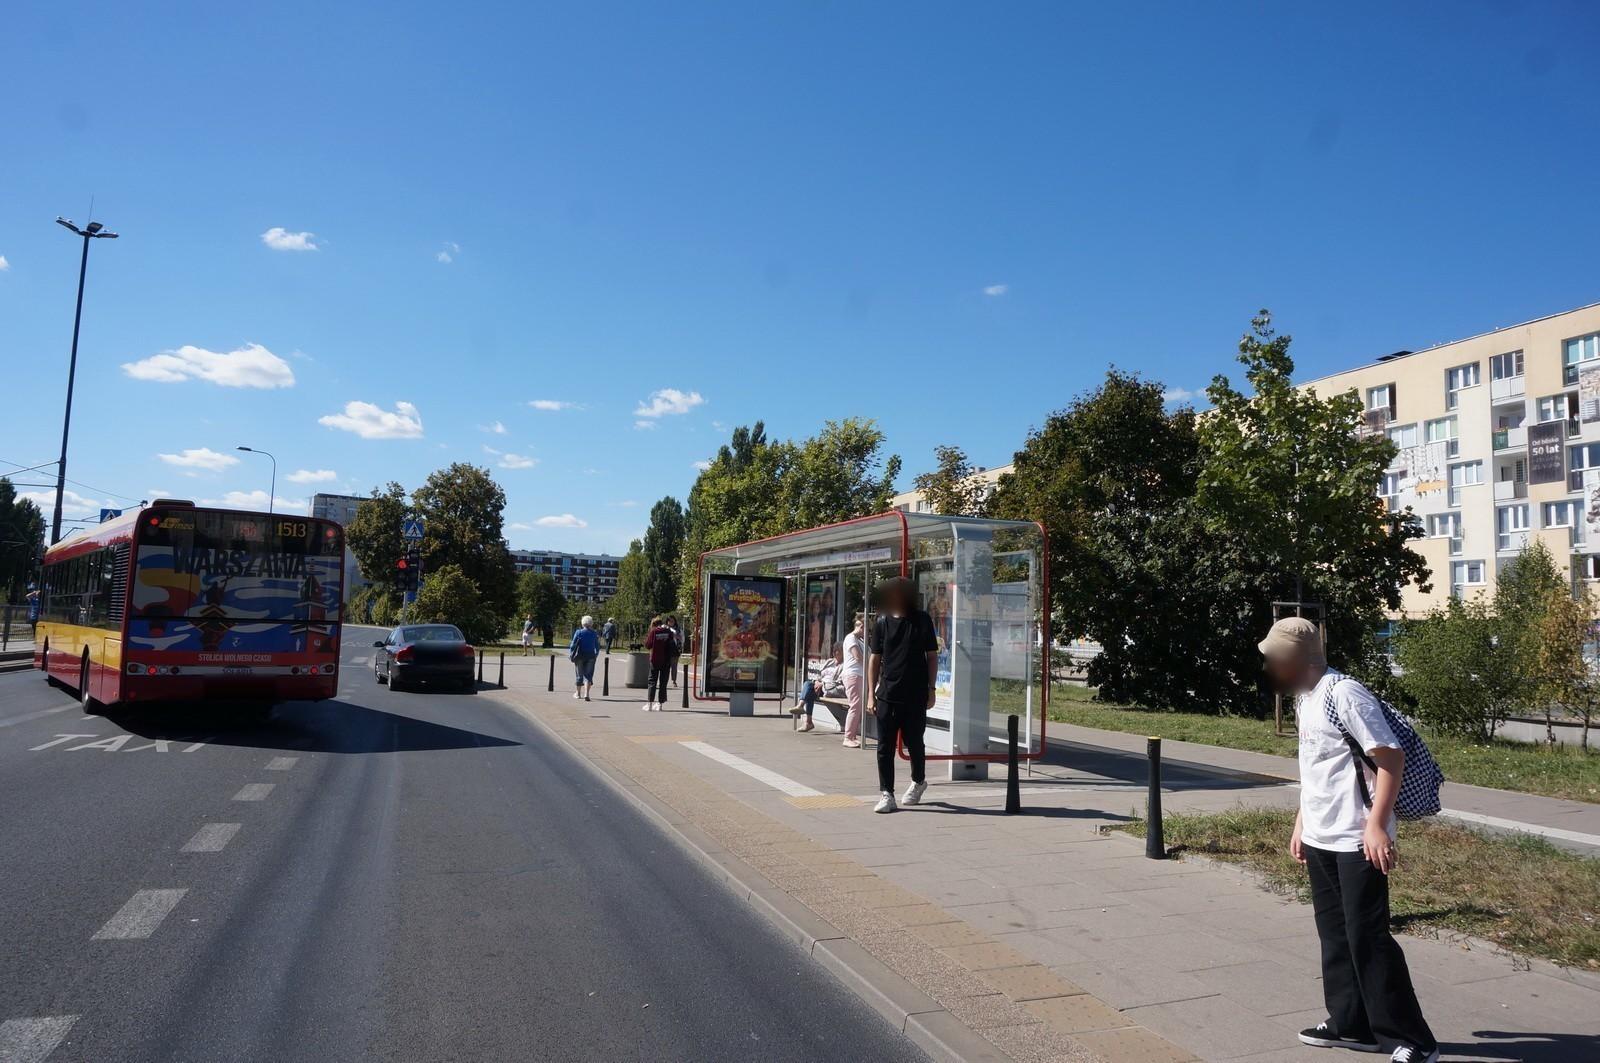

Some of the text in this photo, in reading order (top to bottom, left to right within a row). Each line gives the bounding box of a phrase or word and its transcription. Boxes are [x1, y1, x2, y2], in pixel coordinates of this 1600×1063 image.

[1532, 444, 1560, 456] 50 lat
[277, 521, 306, 538] 1513
[174, 548, 305, 579] WARSZAWA
[28, 734, 208, 753] TAXI
